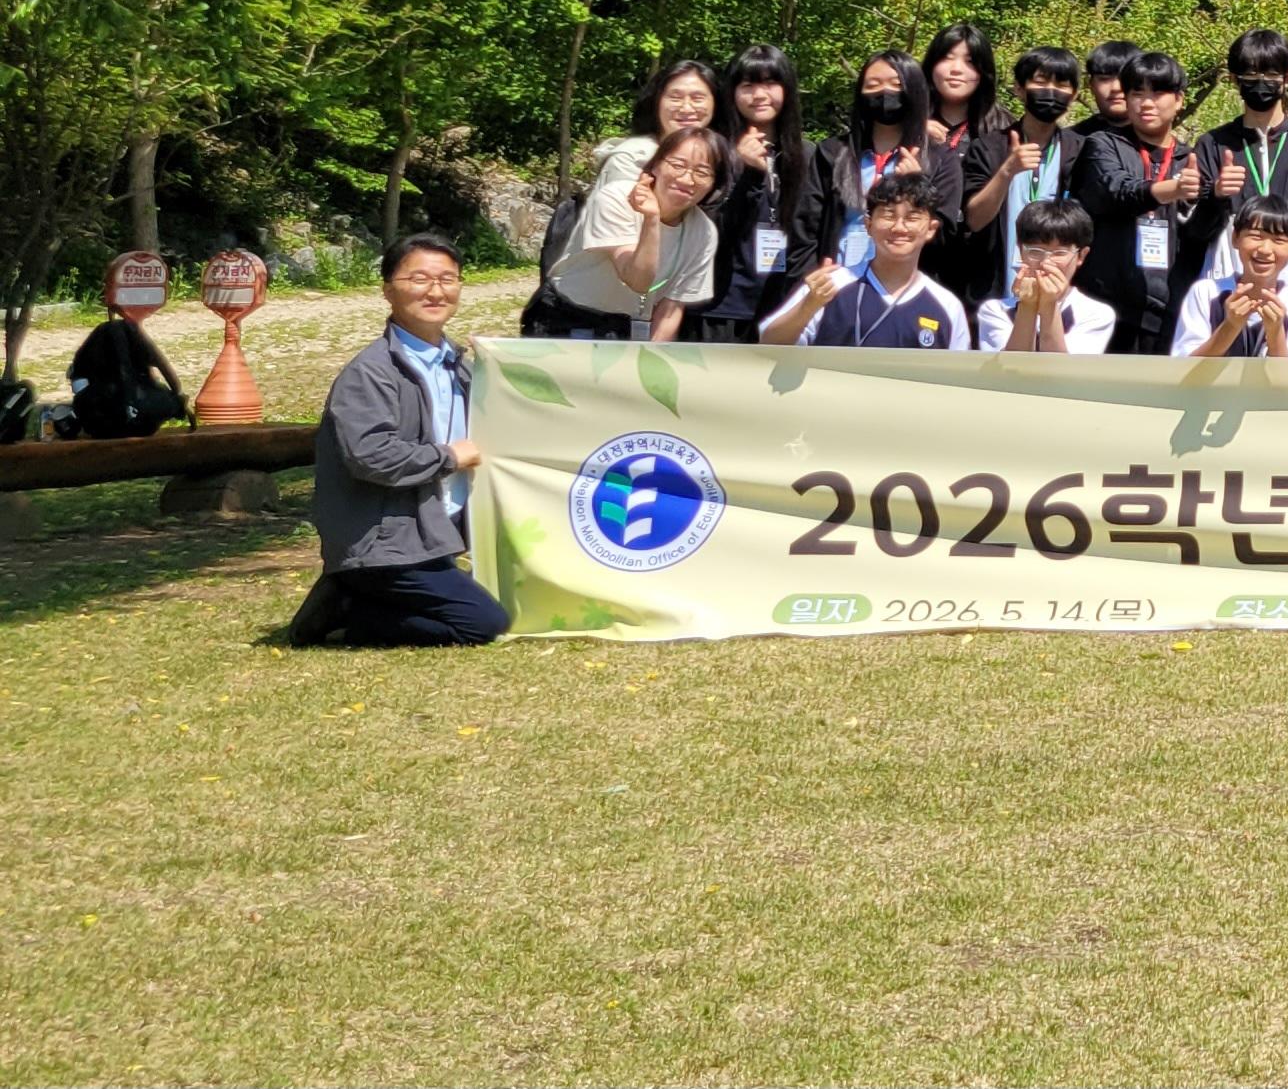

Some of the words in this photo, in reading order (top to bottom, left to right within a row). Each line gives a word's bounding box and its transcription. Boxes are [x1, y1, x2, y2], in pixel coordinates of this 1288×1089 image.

[596, 437, 700, 466] 대전광역시교육청
[580, 524, 643, 567] Metropolitan
[648, 544, 686, 567] Office
[687, 531, 700, 546] of
[695, 475, 720, 531] Education
[790, 597, 859, 623] 일자
